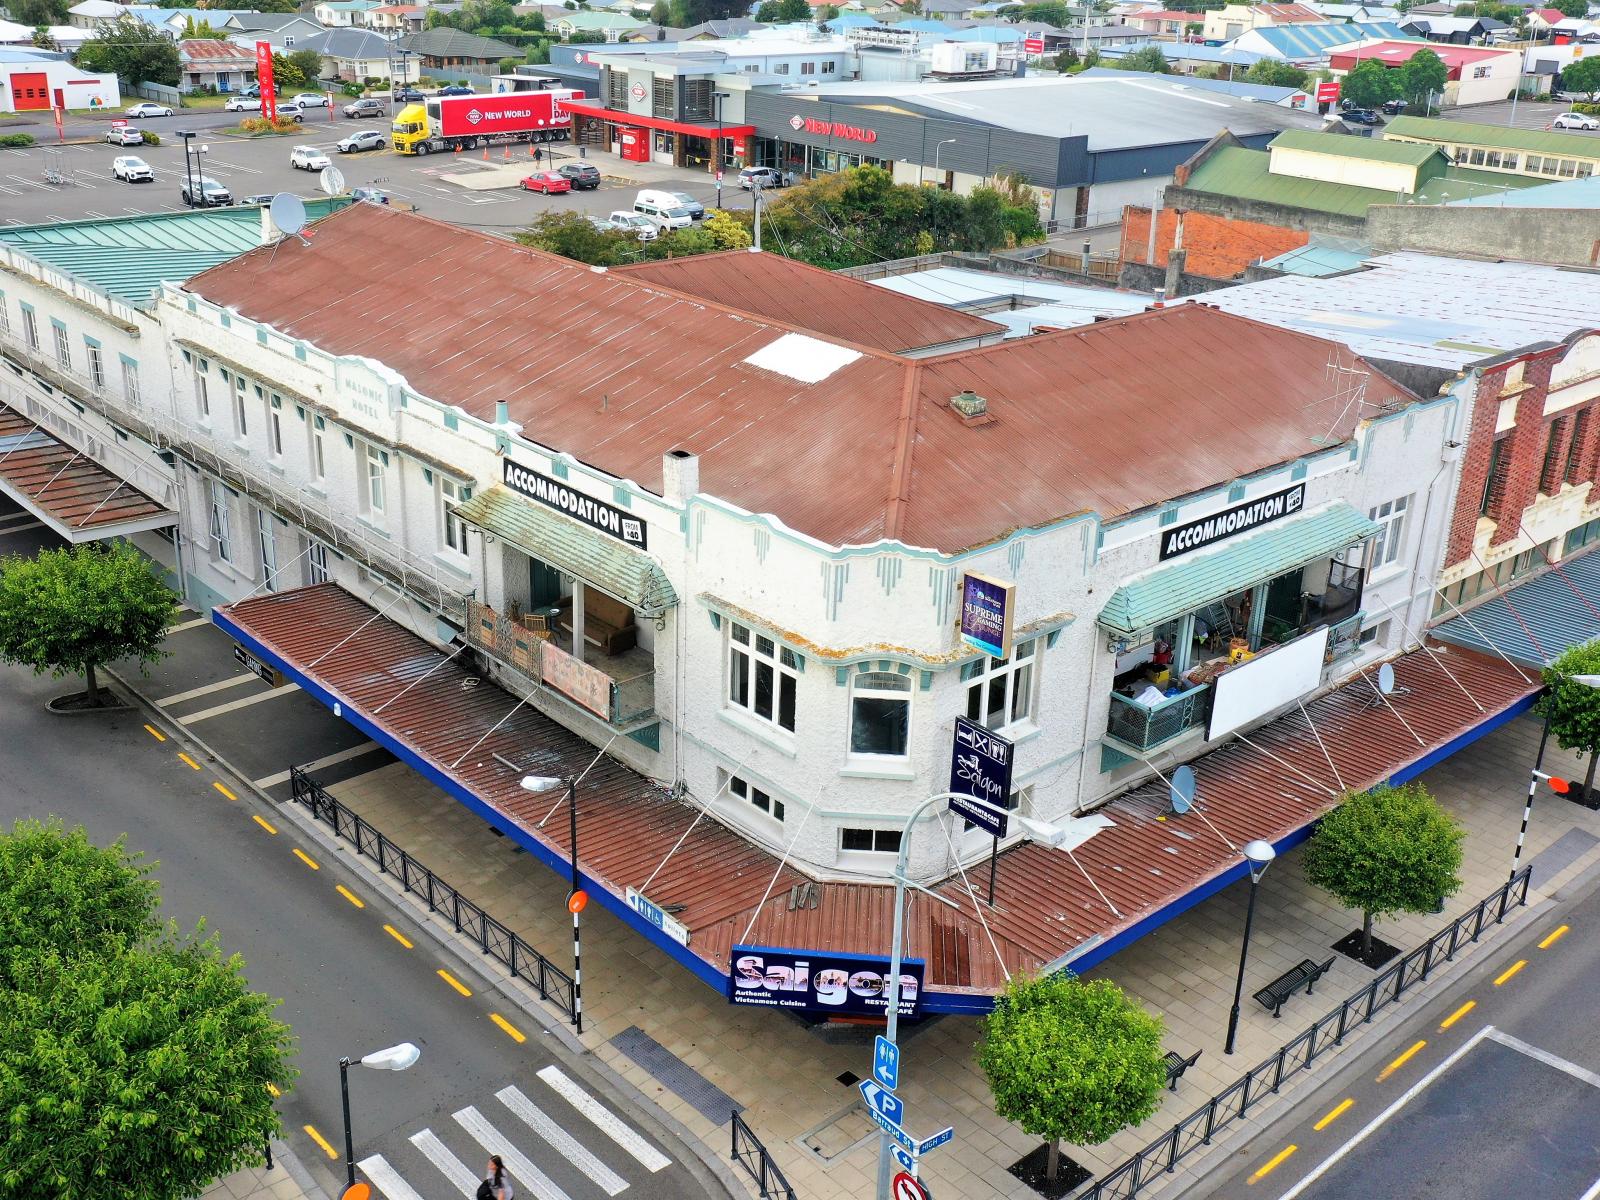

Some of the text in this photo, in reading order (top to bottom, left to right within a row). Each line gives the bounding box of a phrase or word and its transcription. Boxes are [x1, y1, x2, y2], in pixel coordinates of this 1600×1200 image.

[484, 109, 532, 120] NEW WORLD
[554, 110, 570, 119] DAY
[805, 117, 832, 135] NEW
[833, 123, 877, 143] WORLD
[506, 464, 620, 533] ACCOMMODATION
[625, 522, 639, 531] FROM
[1166, 495, 1284, 554] ACCOMMODATION
[964, 602, 1003, 626] SUPREME
[976, 616, 1003, 632] GAMING
[956, 757, 1002, 801] Saigon
[735, 989, 772, 998] Authentic
[735, 997, 807, 1008] Vietnamese Cuisine
[864, 998, 916, 1008] RESTAANT
[882, 1094, 897, 1113] P
[872, 1111, 911, 1149] Barraud St
[921, 1131, 950, 1153] HIGH ST
